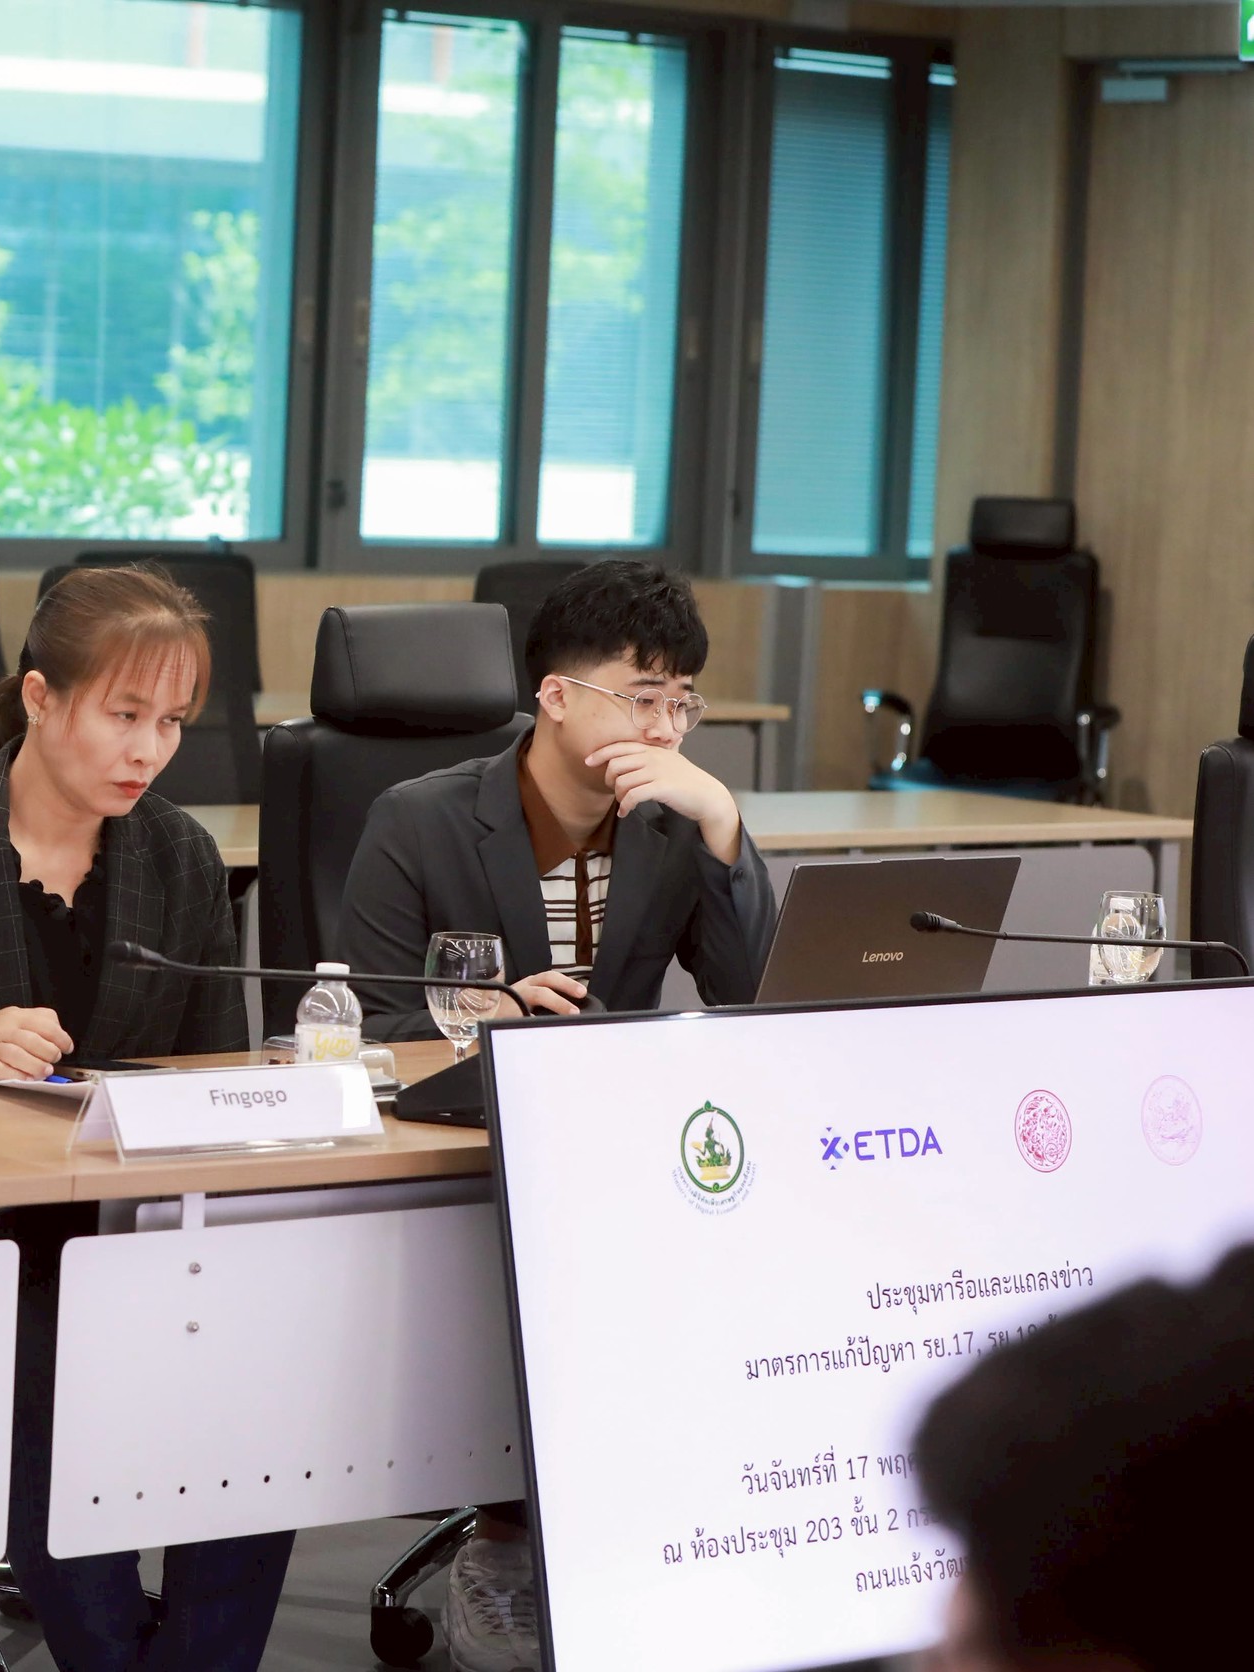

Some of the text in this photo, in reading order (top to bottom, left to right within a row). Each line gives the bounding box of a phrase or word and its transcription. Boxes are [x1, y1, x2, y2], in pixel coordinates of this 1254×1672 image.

[862, 951, 904, 963] Lenovo
[209, 1089, 287, 1108] Fingogo
[853, 1126, 944, 1161] ETDA
[866, 1261, 1095, 1316] ประชุมหารือและแถลงข่าว
[745, 1336, 916, 1382] มาตรการแก้ปัญหา
[741, 1446, 839, 1496] วันจันทร์ที่
[847, 1455, 869, 1481] 17
[663, 1542, 683, 1566] ณ
[690, 1525, 798, 1560] ห้องประชุม
[805, 1516, 843, 1544] 203
[850, 1496, 879, 1538] ชั้น
[886, 1508, 900, 1533] 2
